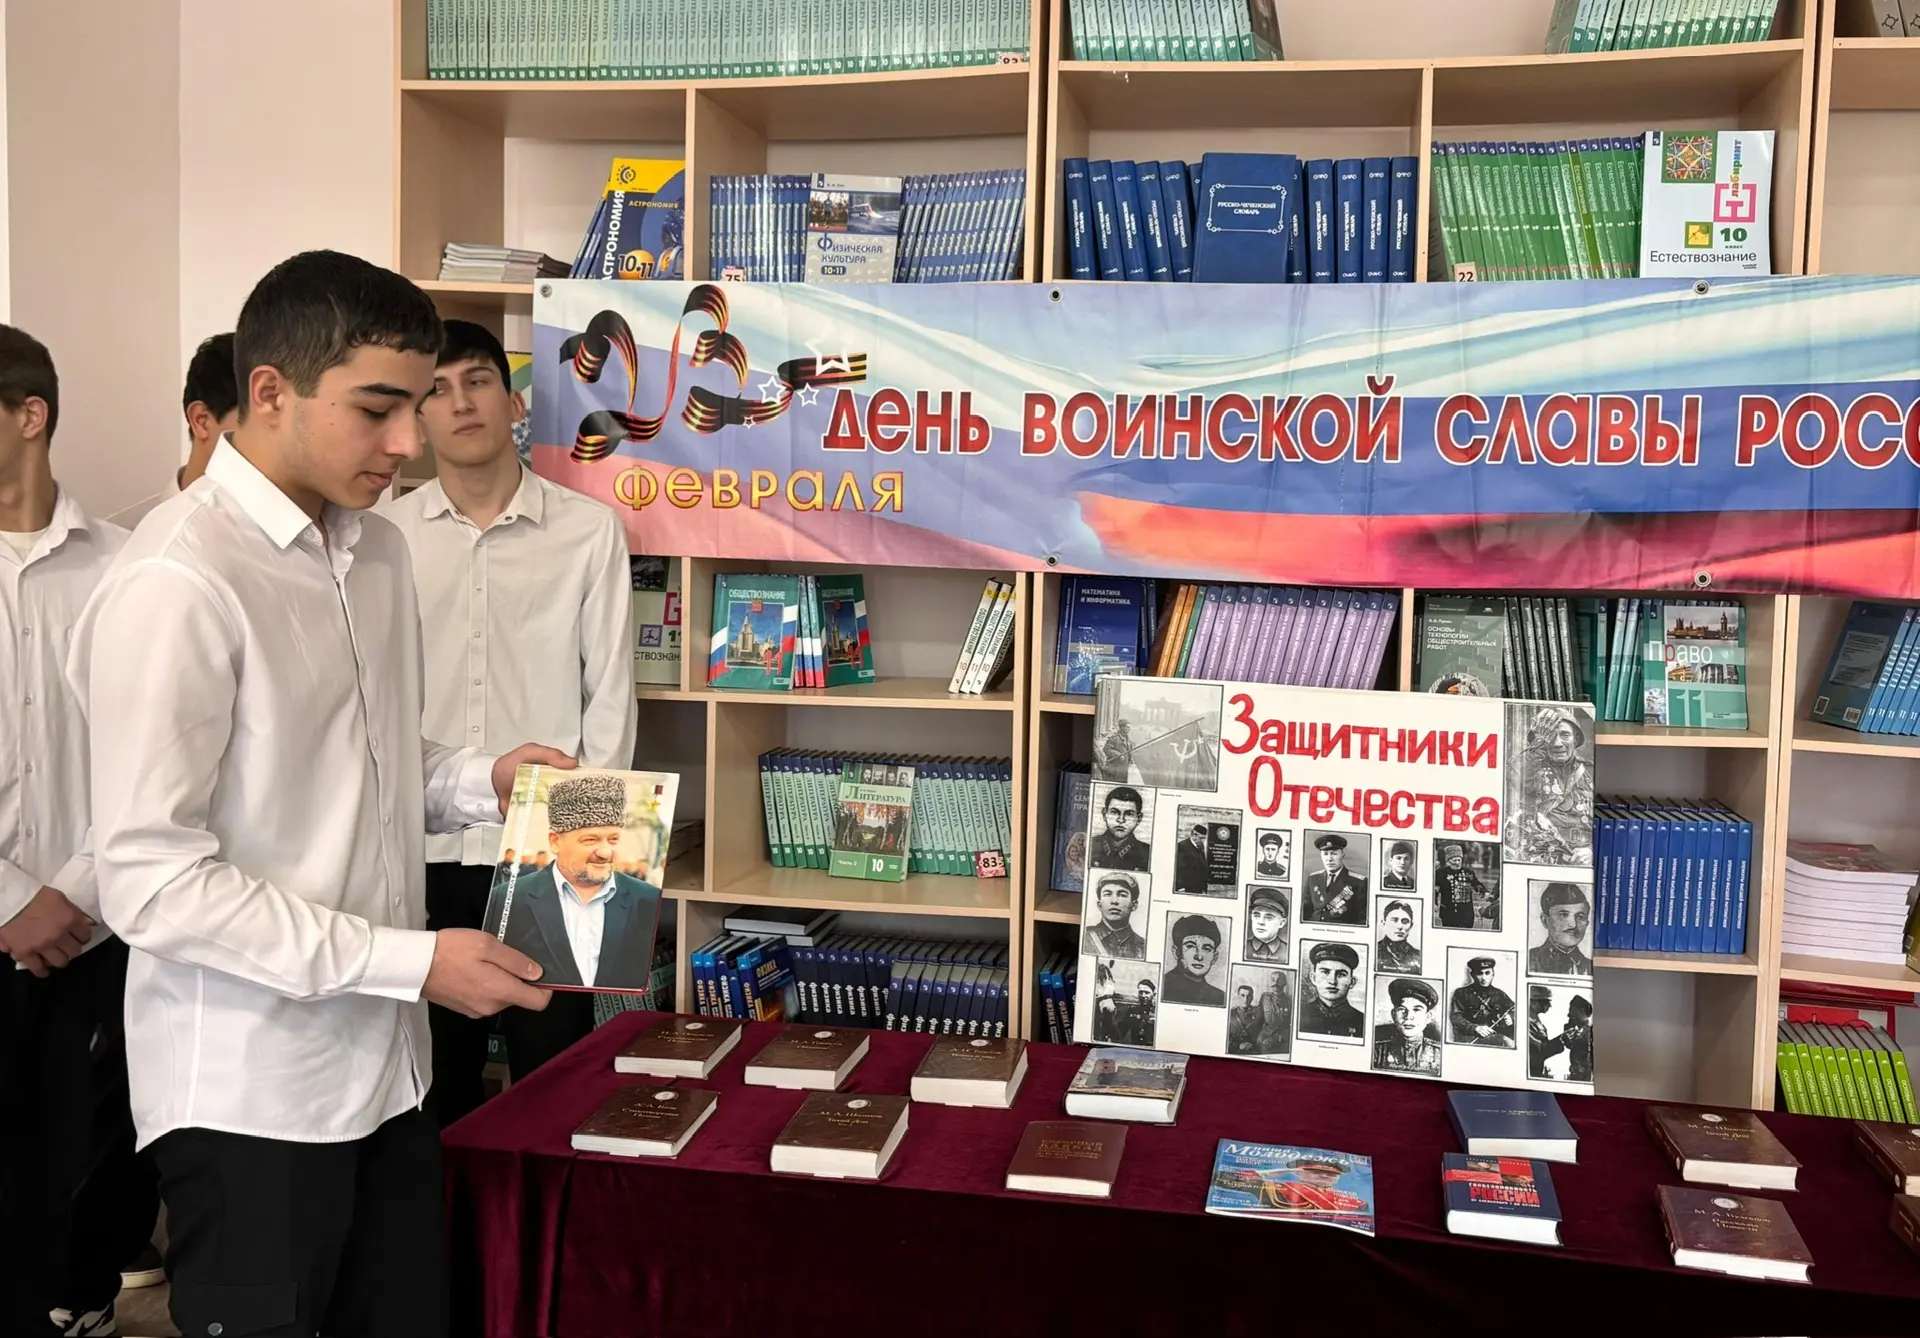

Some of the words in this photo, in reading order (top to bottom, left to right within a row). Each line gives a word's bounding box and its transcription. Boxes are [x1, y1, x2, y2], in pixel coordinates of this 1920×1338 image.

[629, 201, 678, 209] АСТРОНОМИЯ
[1720, 228, 1747, 242] 10
[821, 255, 866, 264] КУЛЬТУРА
[1650, 251, 1756, 262] Естествознание
[1021, 374, 1403, 464] ВОИНСКОЙ
[1434, 391, 1702, 466] СЛАВЫ
[729, 589, 786, 599] ОБЩЕСТВОЗНАНИЕ
[1427, 638, 1496, 647] ОБЩЕСТРОИТЕЛЬНЫХ
[1649, 640, 1712, 666] Право
[764, 649, 782, 675] 11
[1221, 693, 1498, 769] Защитники
[1249, 756, 1500, 836] Отечества
[872, 859, 883, 872] 10
[983, 857, 997, 868] 83
[756, 959, 777, 977] ФИЗИКА
[1470, 1187, 1540, 1204] РОССИИ
